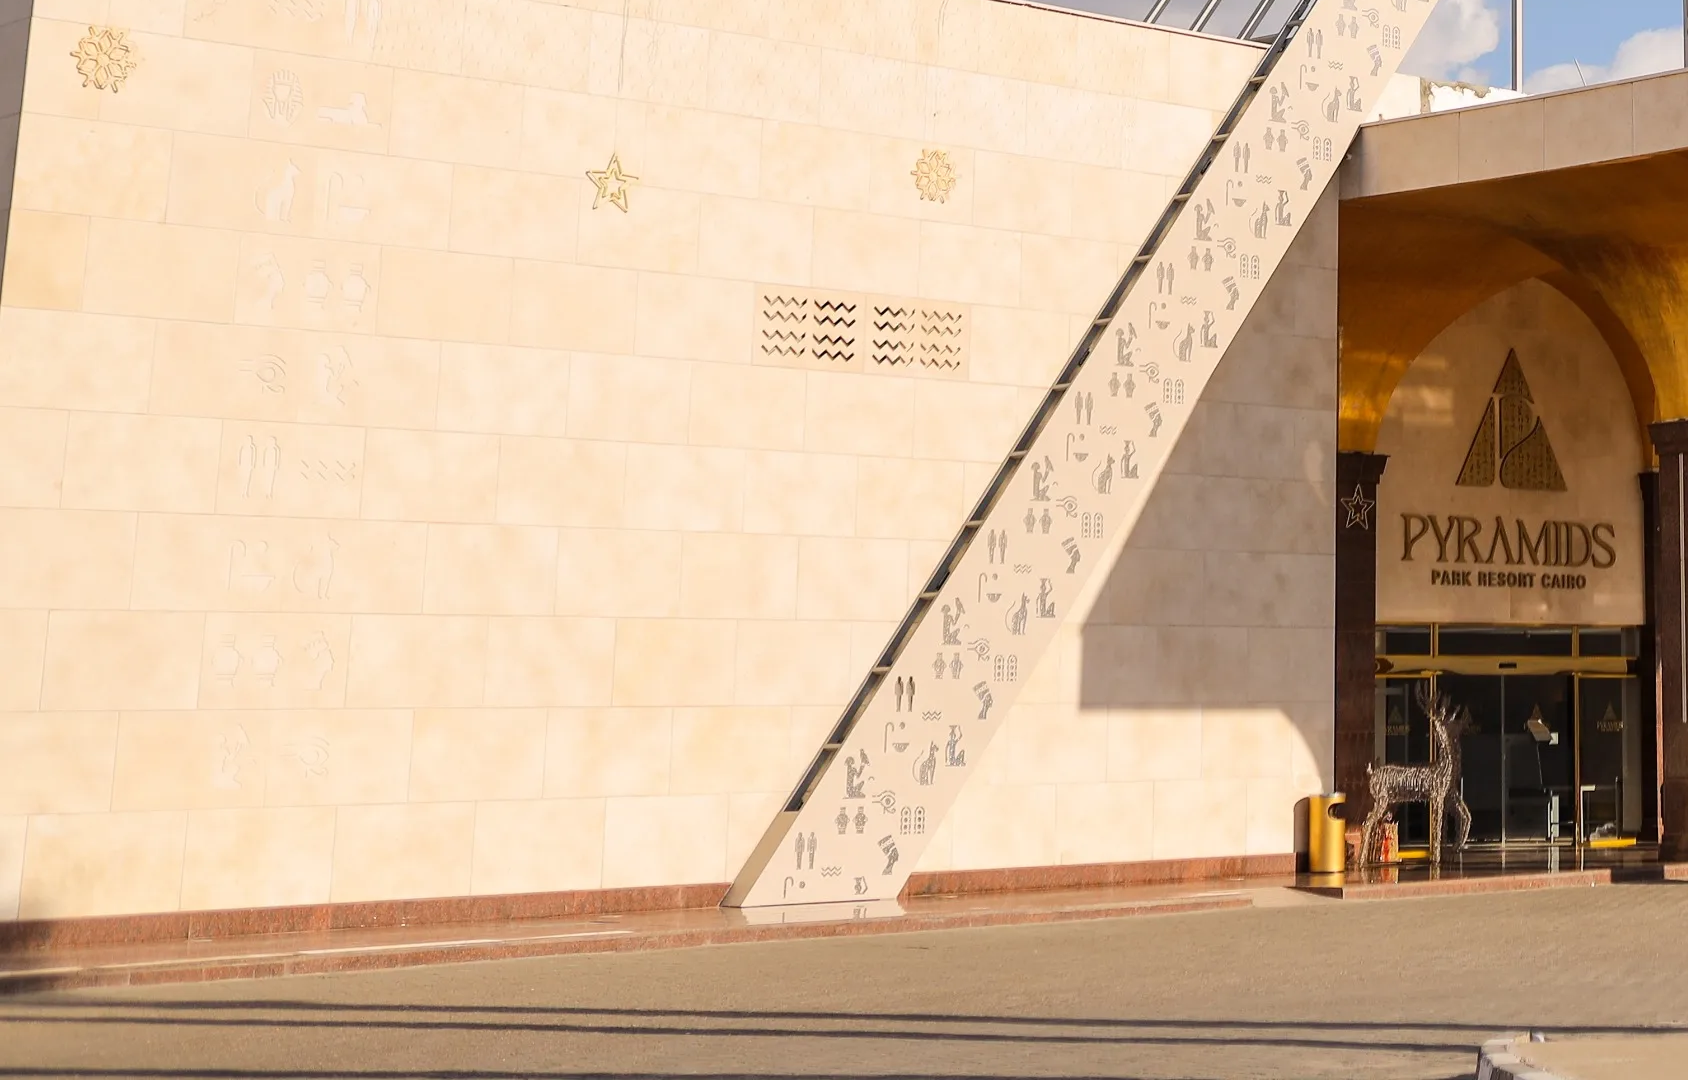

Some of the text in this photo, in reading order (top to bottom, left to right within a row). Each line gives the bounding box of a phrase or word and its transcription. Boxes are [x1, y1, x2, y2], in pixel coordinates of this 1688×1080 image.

[1400, 512, 1617, 569] PYRAMIDS
[1431, 569, 1587, 590] PARK RESORT CAIRO
